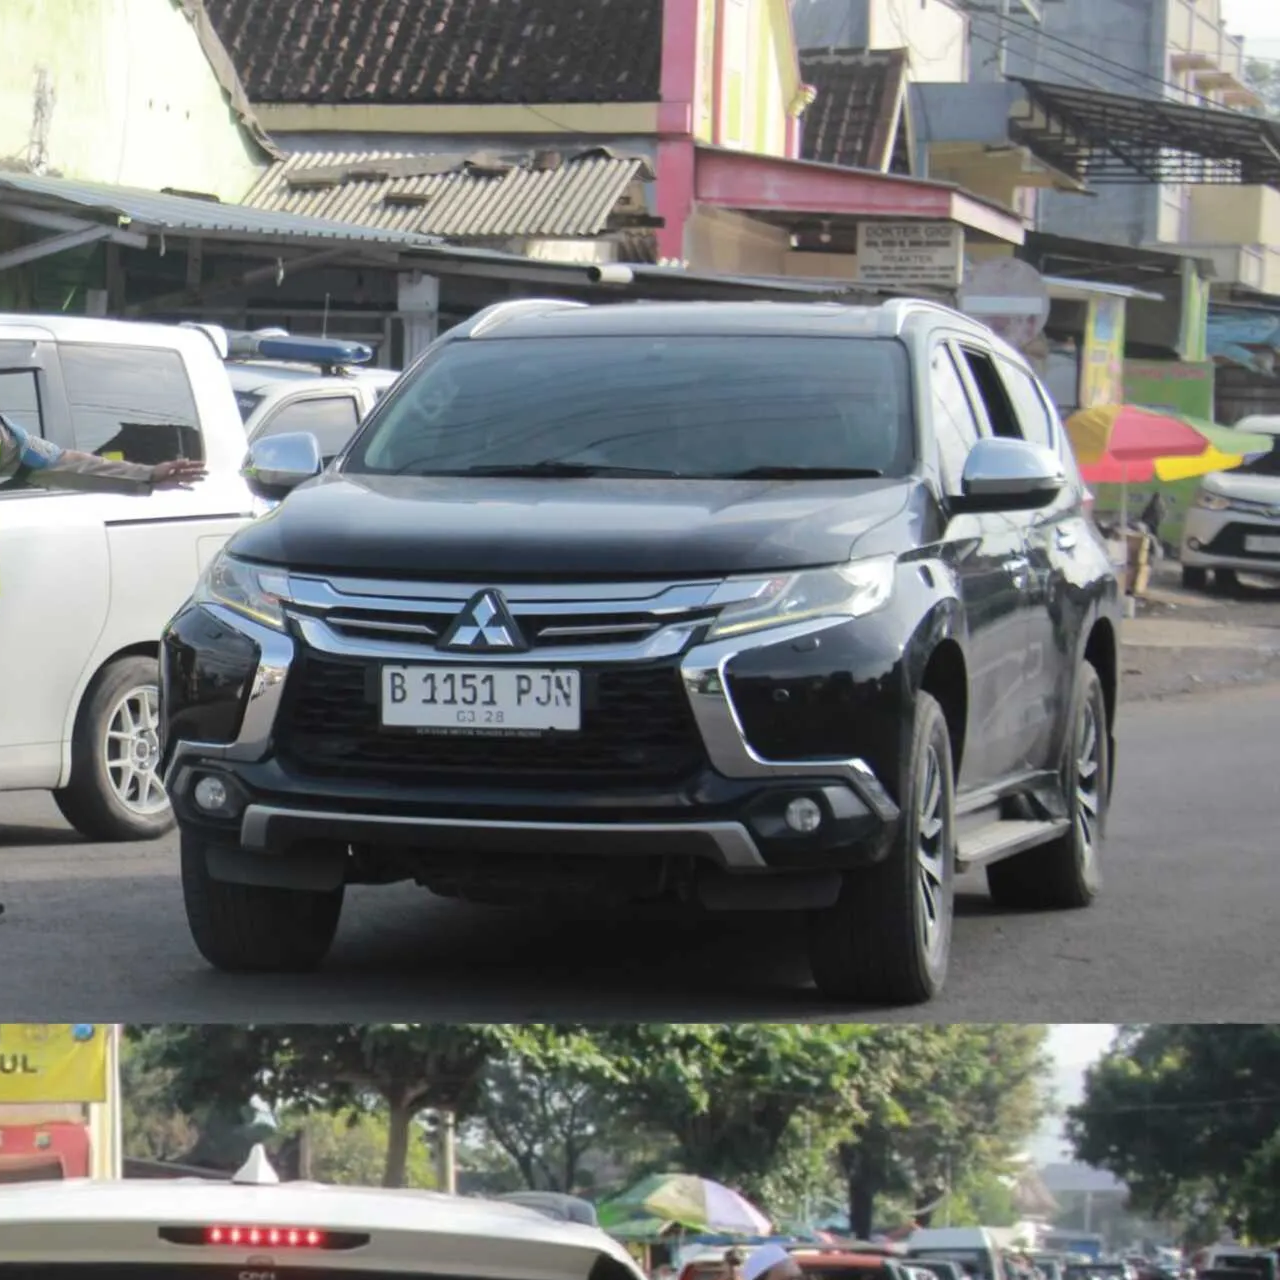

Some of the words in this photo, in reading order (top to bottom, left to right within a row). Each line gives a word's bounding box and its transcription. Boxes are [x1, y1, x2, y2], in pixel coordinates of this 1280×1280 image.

[390, 672, 407, 704] B
[422, 673, 497, 706] 1151
[516, 674, 572, 707] PJN
